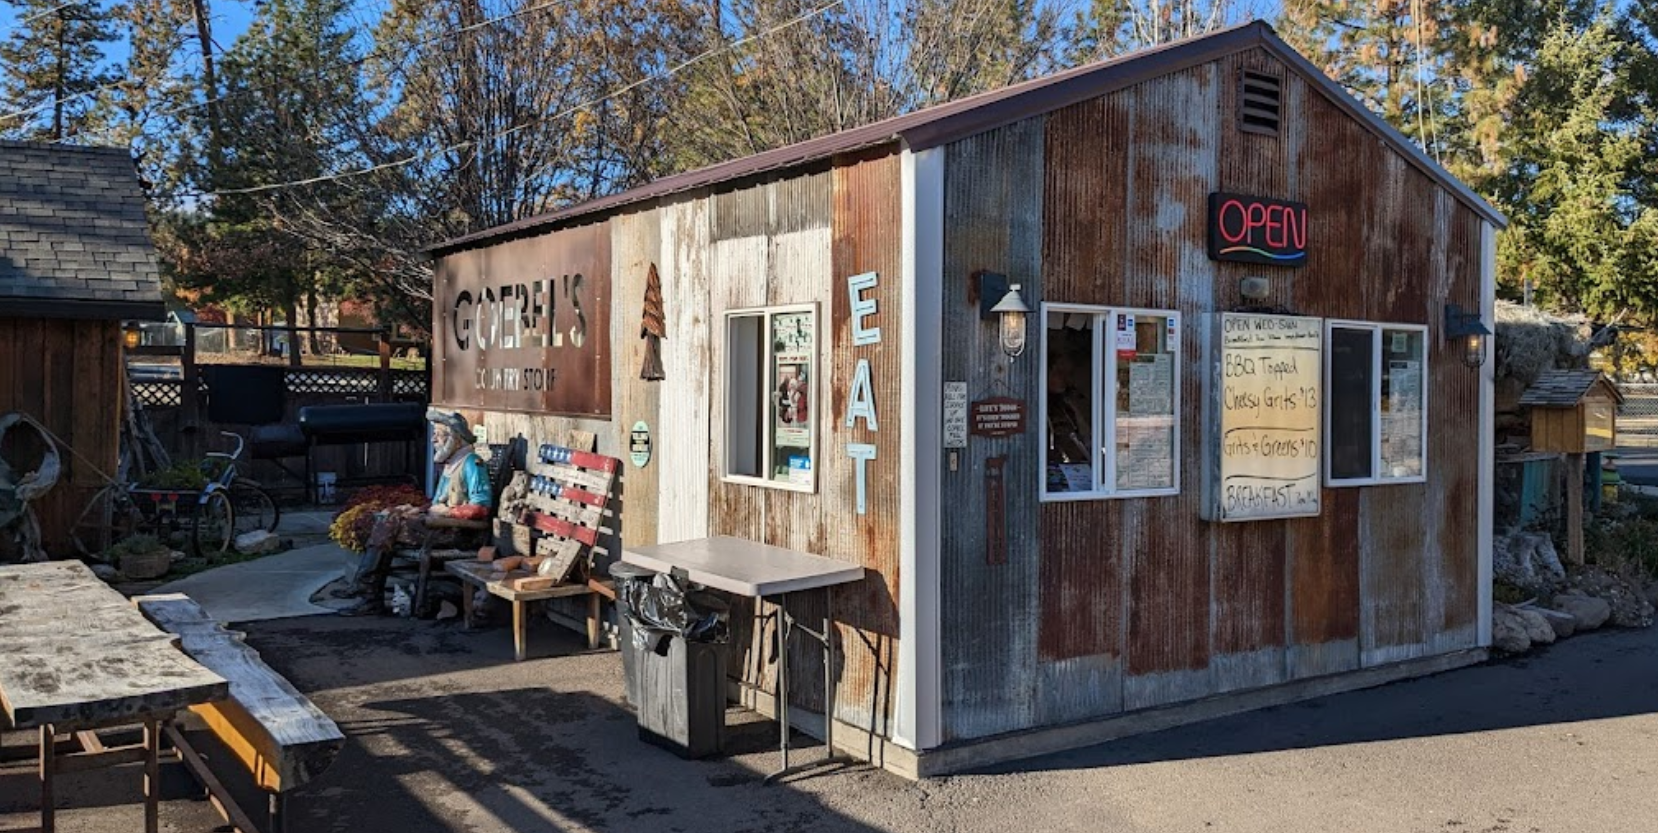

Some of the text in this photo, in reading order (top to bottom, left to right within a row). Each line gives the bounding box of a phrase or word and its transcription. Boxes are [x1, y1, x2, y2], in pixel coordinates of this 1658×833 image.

[1219, 199, 1307, 249] OPEN
[453, 273, 587, 351] GOEBEL'S
[1224, 317, 1250, 333] OPEN
[475, 367, 557, 391] COUNTRY STORE
[1225, 353, 1299, 381] BBQ Topped
[845, 271, 881, 515] EAT
[1224, 385, 1260, 418] Cheesy
[1263, 386, 1296, 411] Grits
[1224, 434, 1251, 458] Grits
[1260, 434, 1300, 458] Greens
[1299, 437, 1318, 458] $10
[1226, 483, 1297, 511] BREAKFAST
